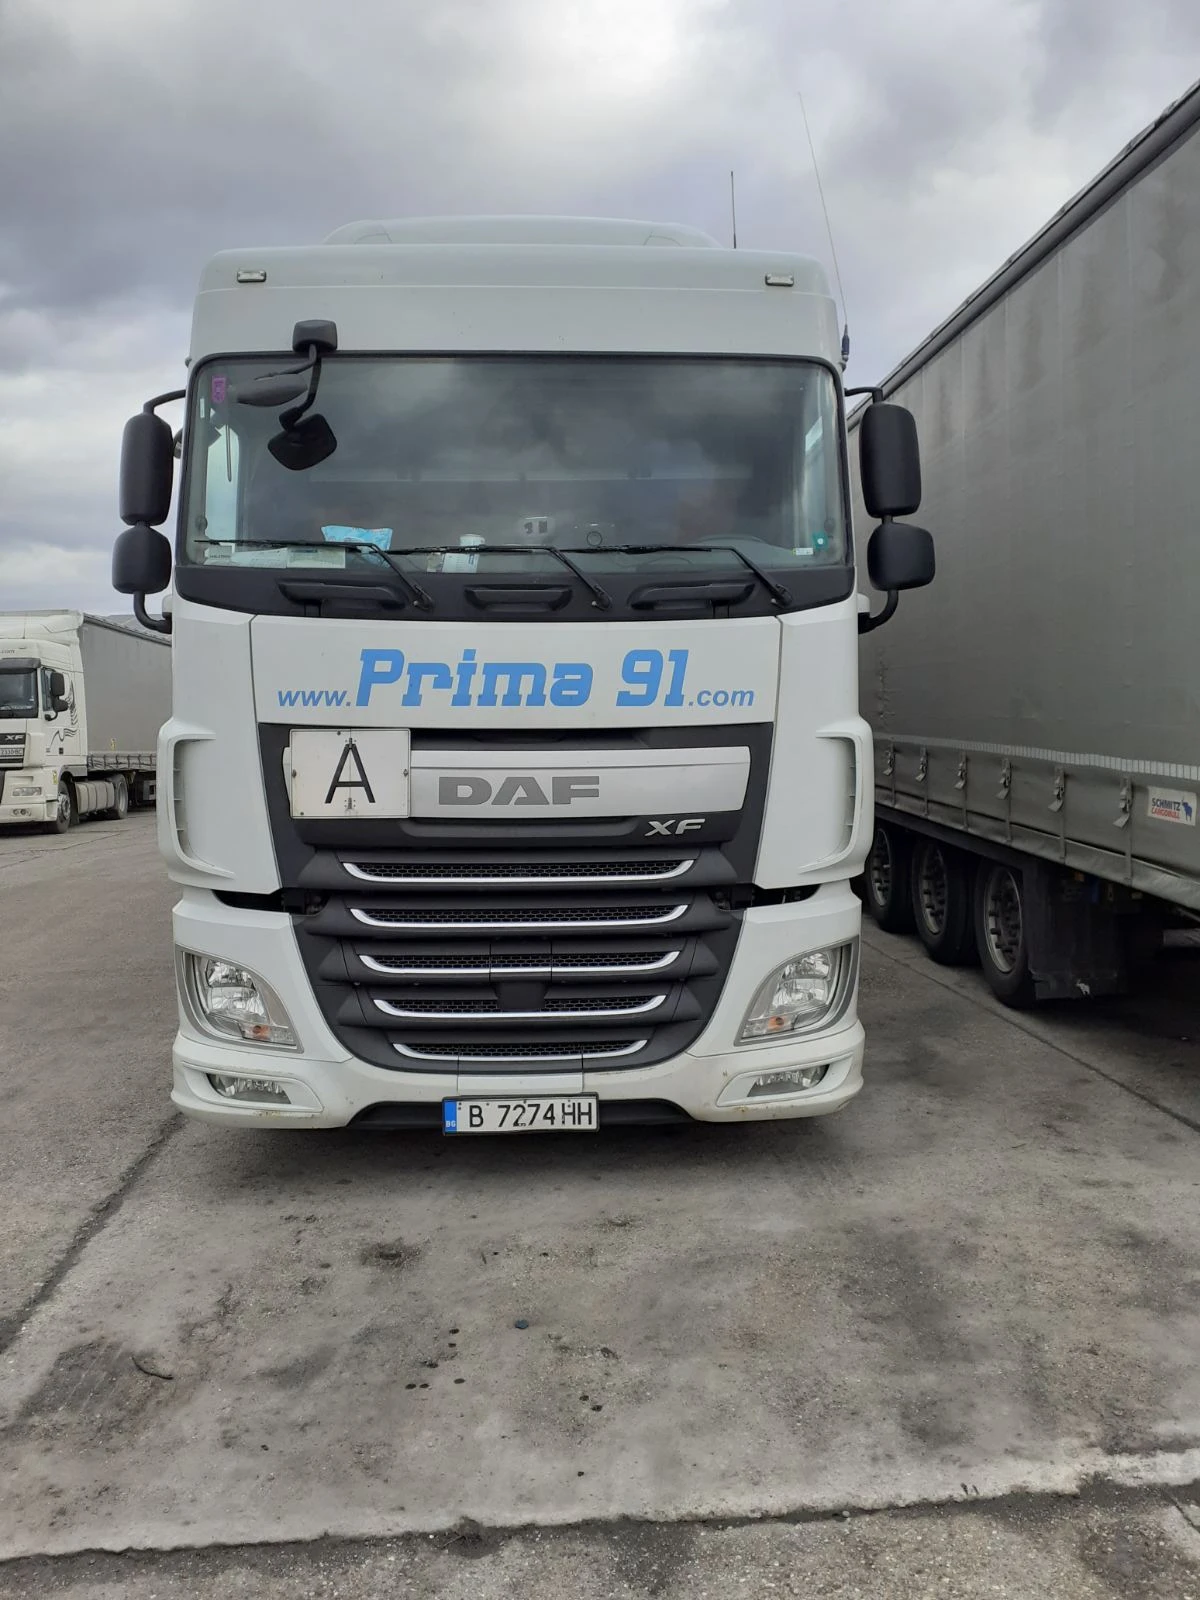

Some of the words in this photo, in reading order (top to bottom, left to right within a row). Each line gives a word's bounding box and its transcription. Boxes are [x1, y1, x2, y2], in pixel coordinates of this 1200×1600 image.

[325, 742, 376, 804] A
[438, 776, 600, 805] DAF
[1151, 798, 1181, 812] SCHMITZ
[644, 818, 706, 837] XF
[445, 1120, 456, 1128] BG
[469, 1105, 484, 1127] B
[498, 1103, 556, 1127] 7274
